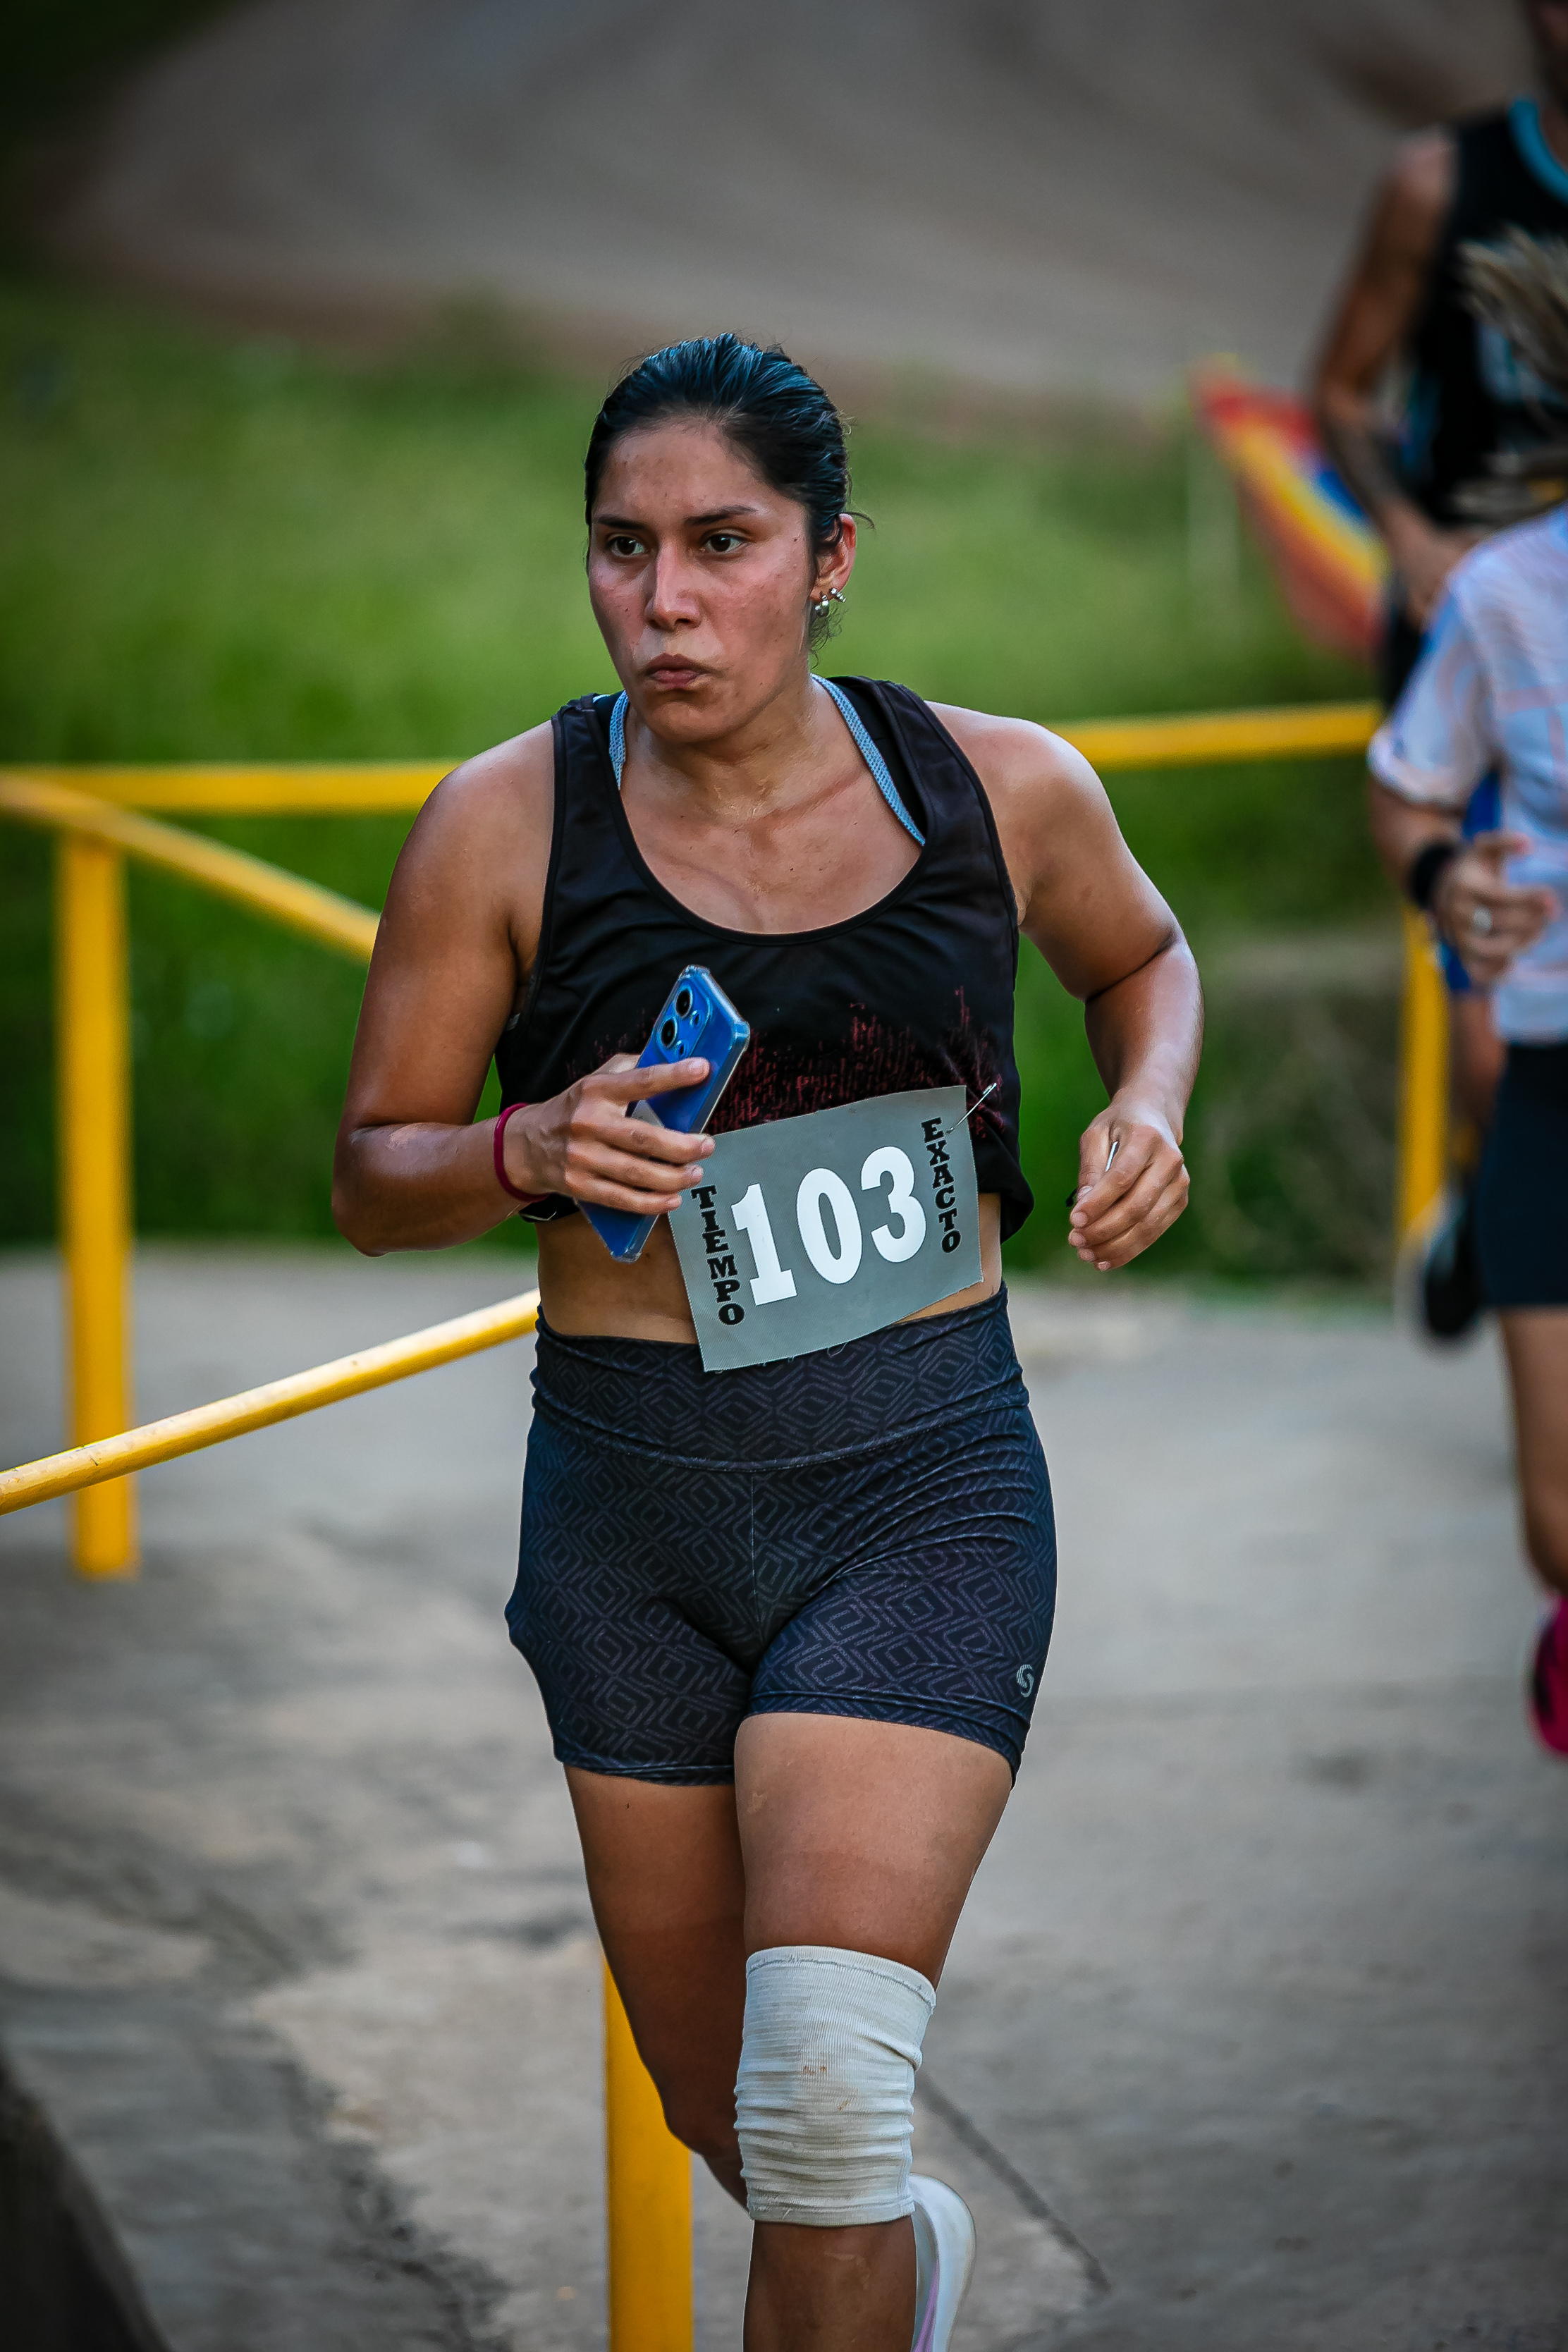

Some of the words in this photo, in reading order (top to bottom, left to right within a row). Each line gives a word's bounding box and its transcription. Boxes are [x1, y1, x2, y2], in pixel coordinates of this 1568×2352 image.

[690, 1185, 745, 1325] TIEMPO
[731, 1146, 926, 1306] 103
[921, 1117, 962, 1254] EXACTO
